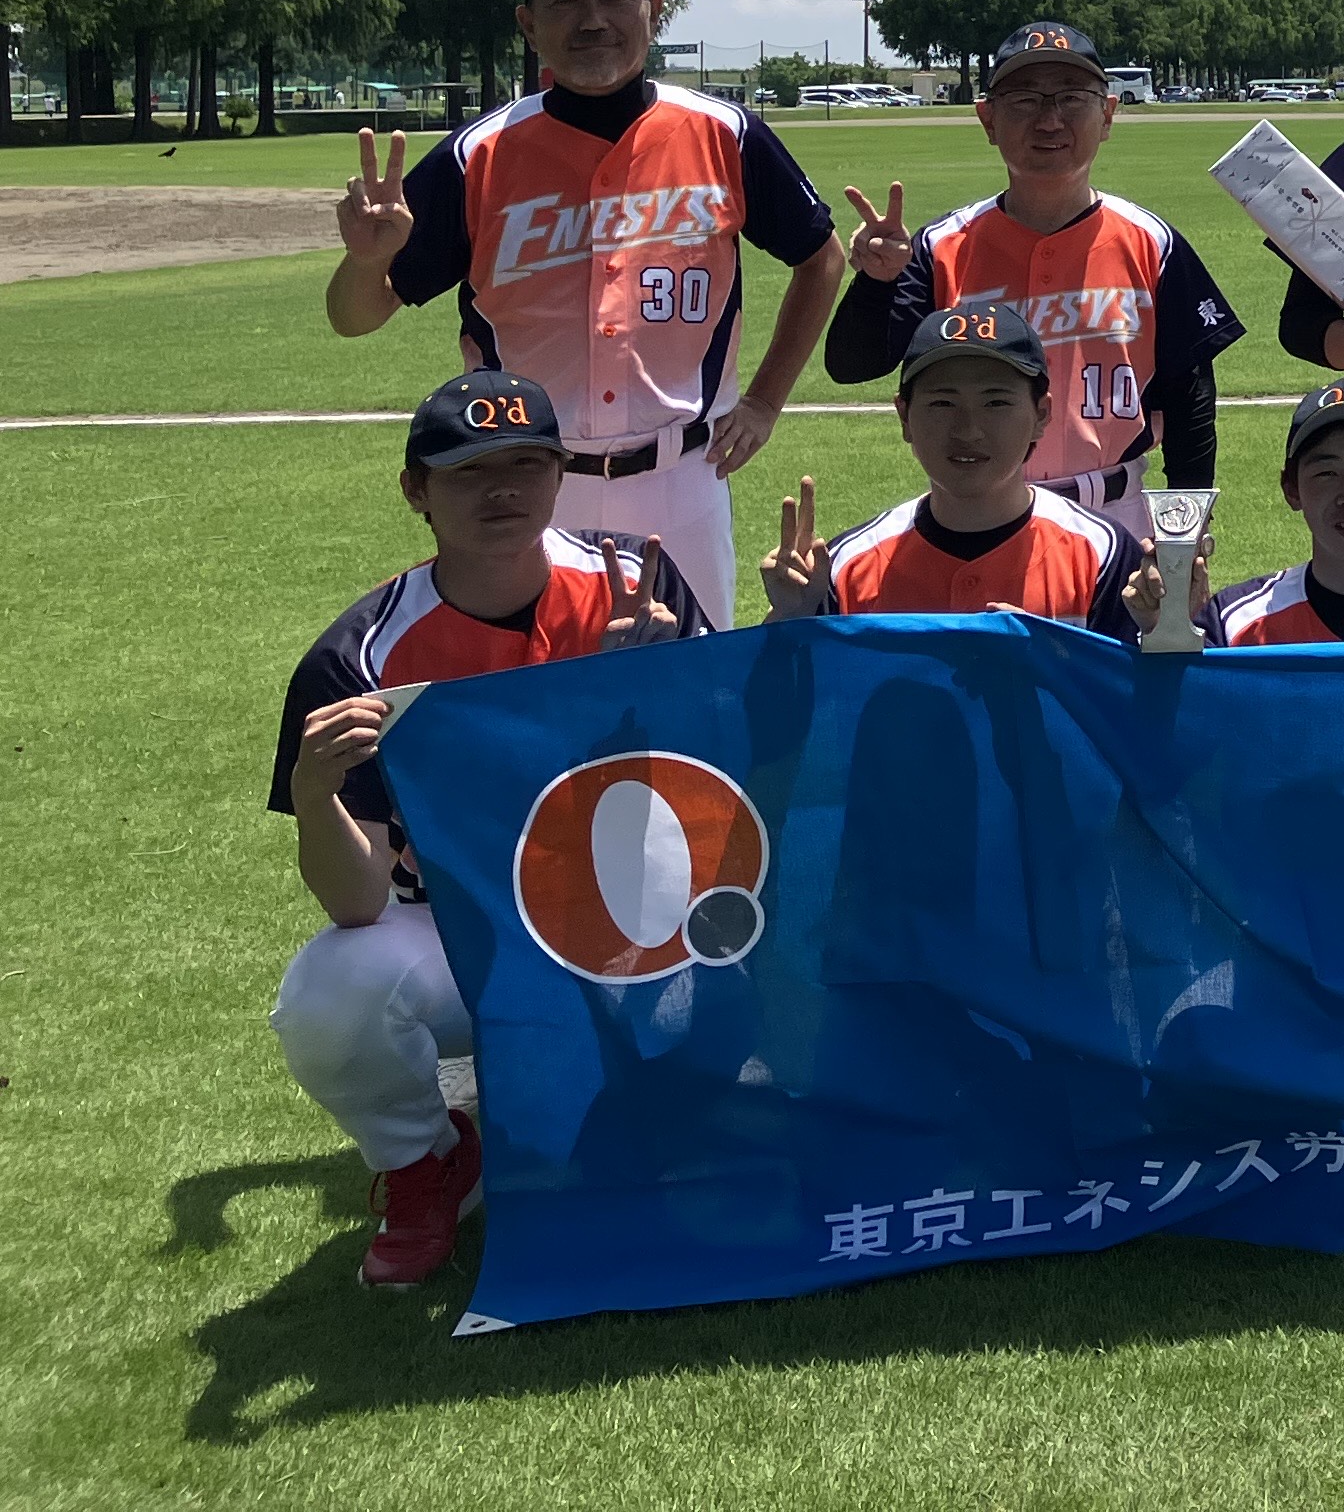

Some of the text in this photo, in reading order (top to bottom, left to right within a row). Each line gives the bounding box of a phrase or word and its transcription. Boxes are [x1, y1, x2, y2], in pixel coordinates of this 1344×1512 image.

[492, 184, 728, 288] ENESYS
[640, 266, 711, 322] 30
[1197, 298, 1226, 328] 東
[939, 314, 998, 341] Q'd
[464, 396, 531, 429] Q'd
[1081, 363, 1141, 420] 10
